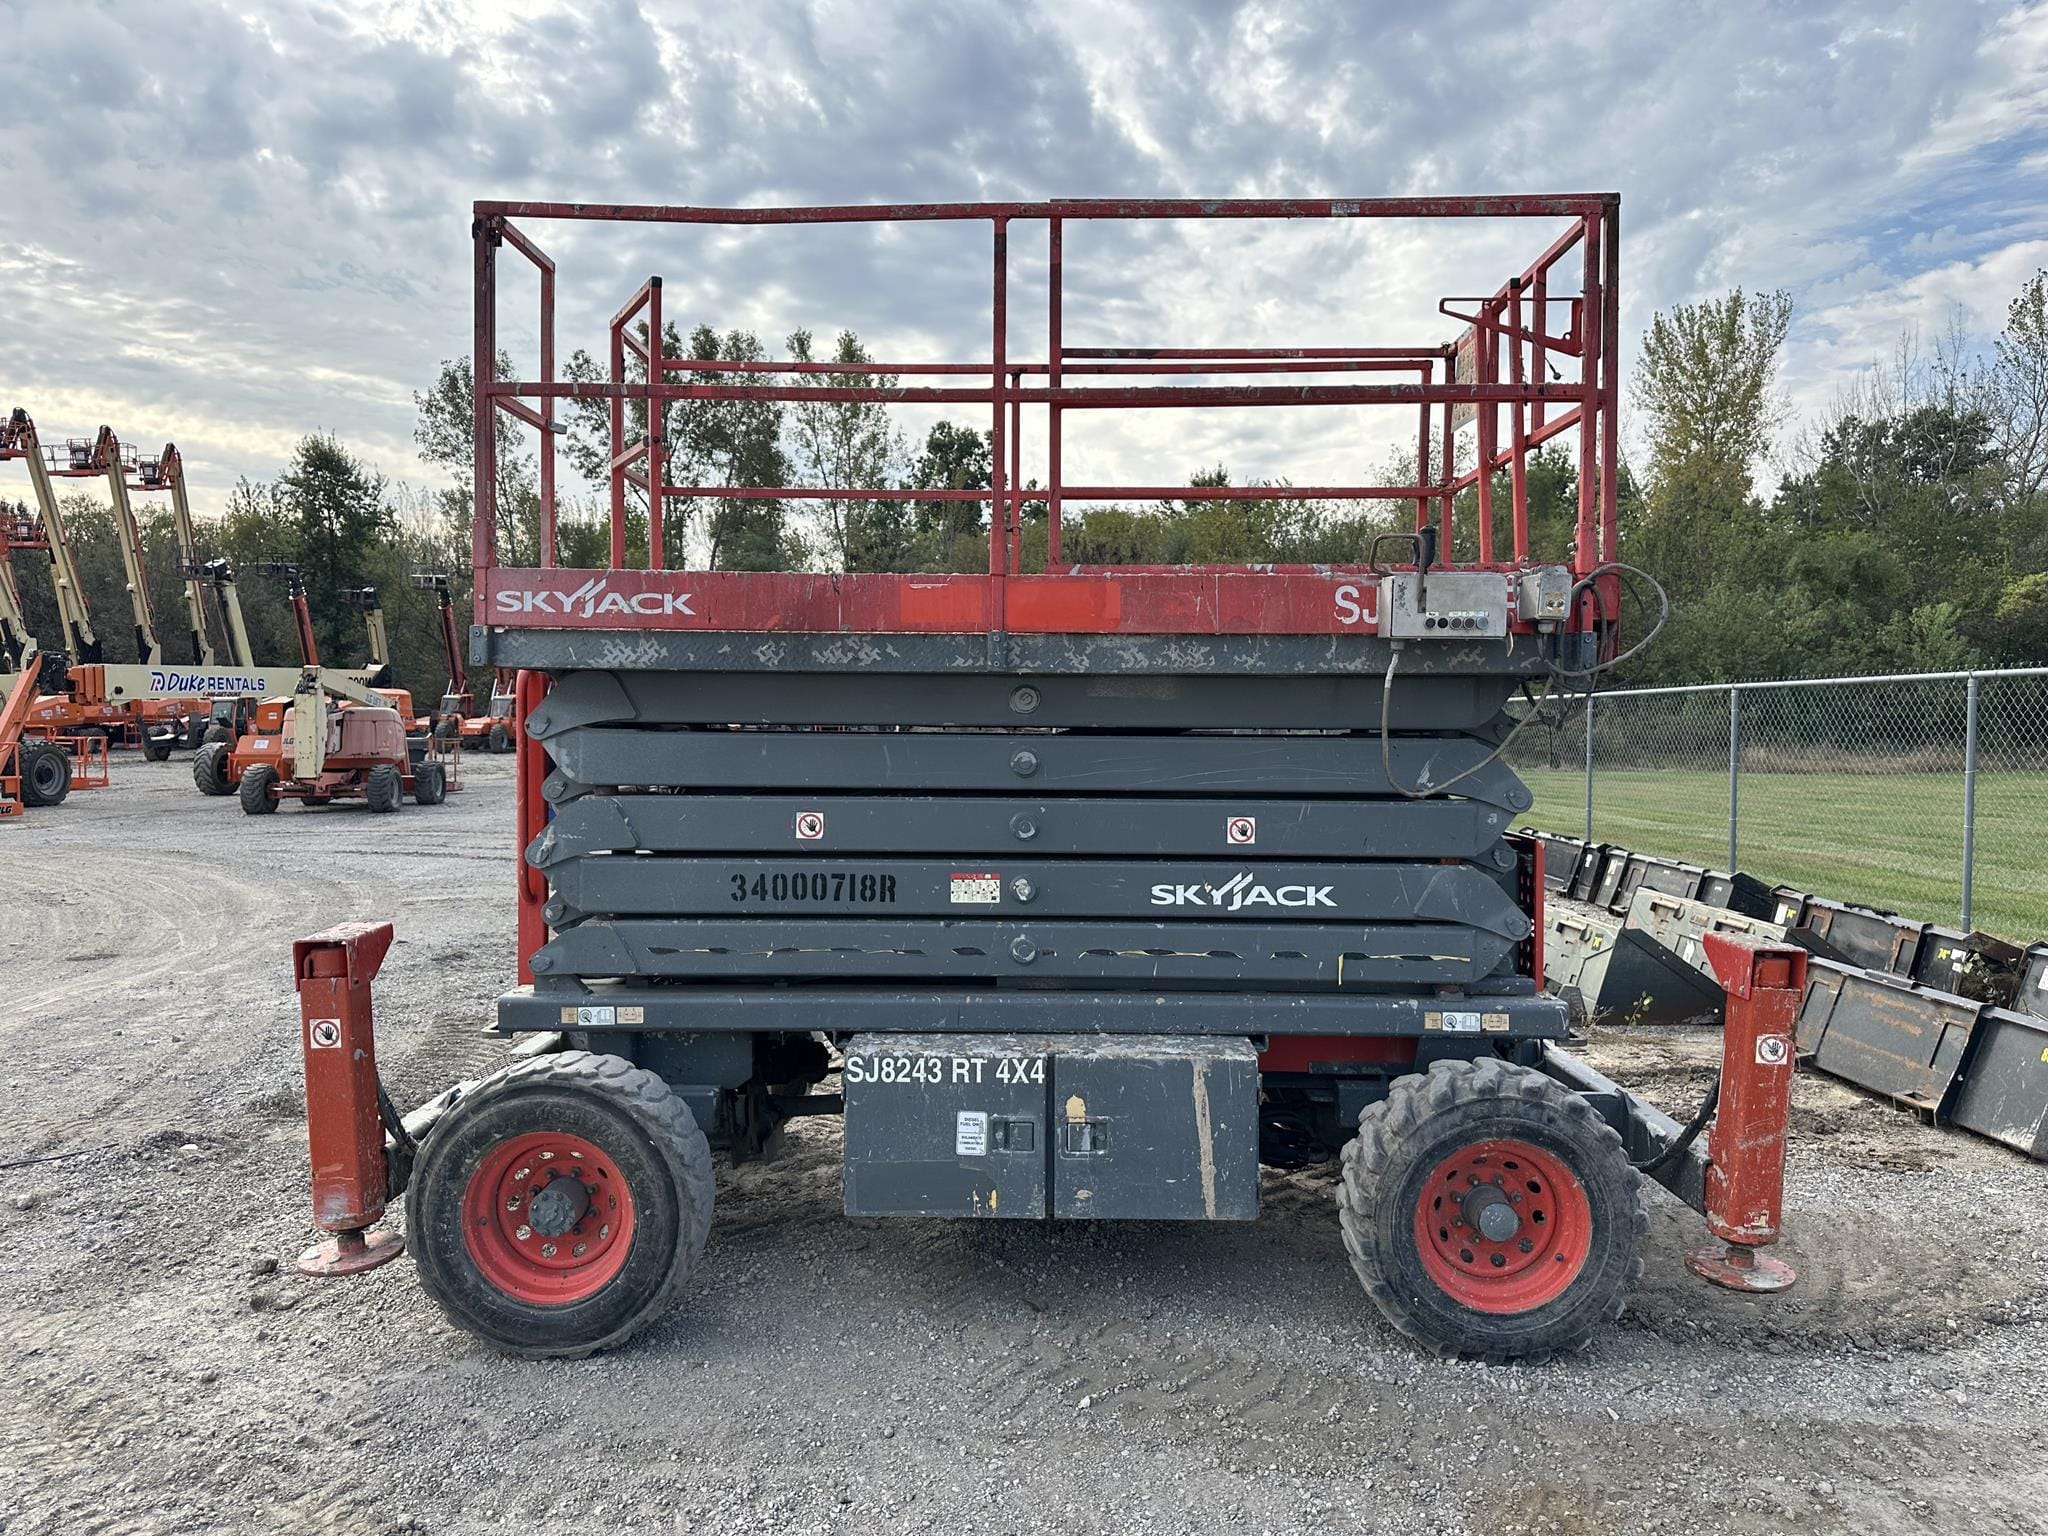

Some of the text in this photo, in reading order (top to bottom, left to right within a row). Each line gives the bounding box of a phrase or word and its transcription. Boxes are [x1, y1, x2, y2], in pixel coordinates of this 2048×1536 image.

[496, 577, 696, 618] SKYJACK
[208, 677, 265, 691] RENTALS
[0, 805, 12, 814] LG
[730, 873, 897, 903] 34000718R
[1150, 872, 1338, 911] SKYJACK
[846, 1056, 1045, 1084] SJ8243 RT 4X4
